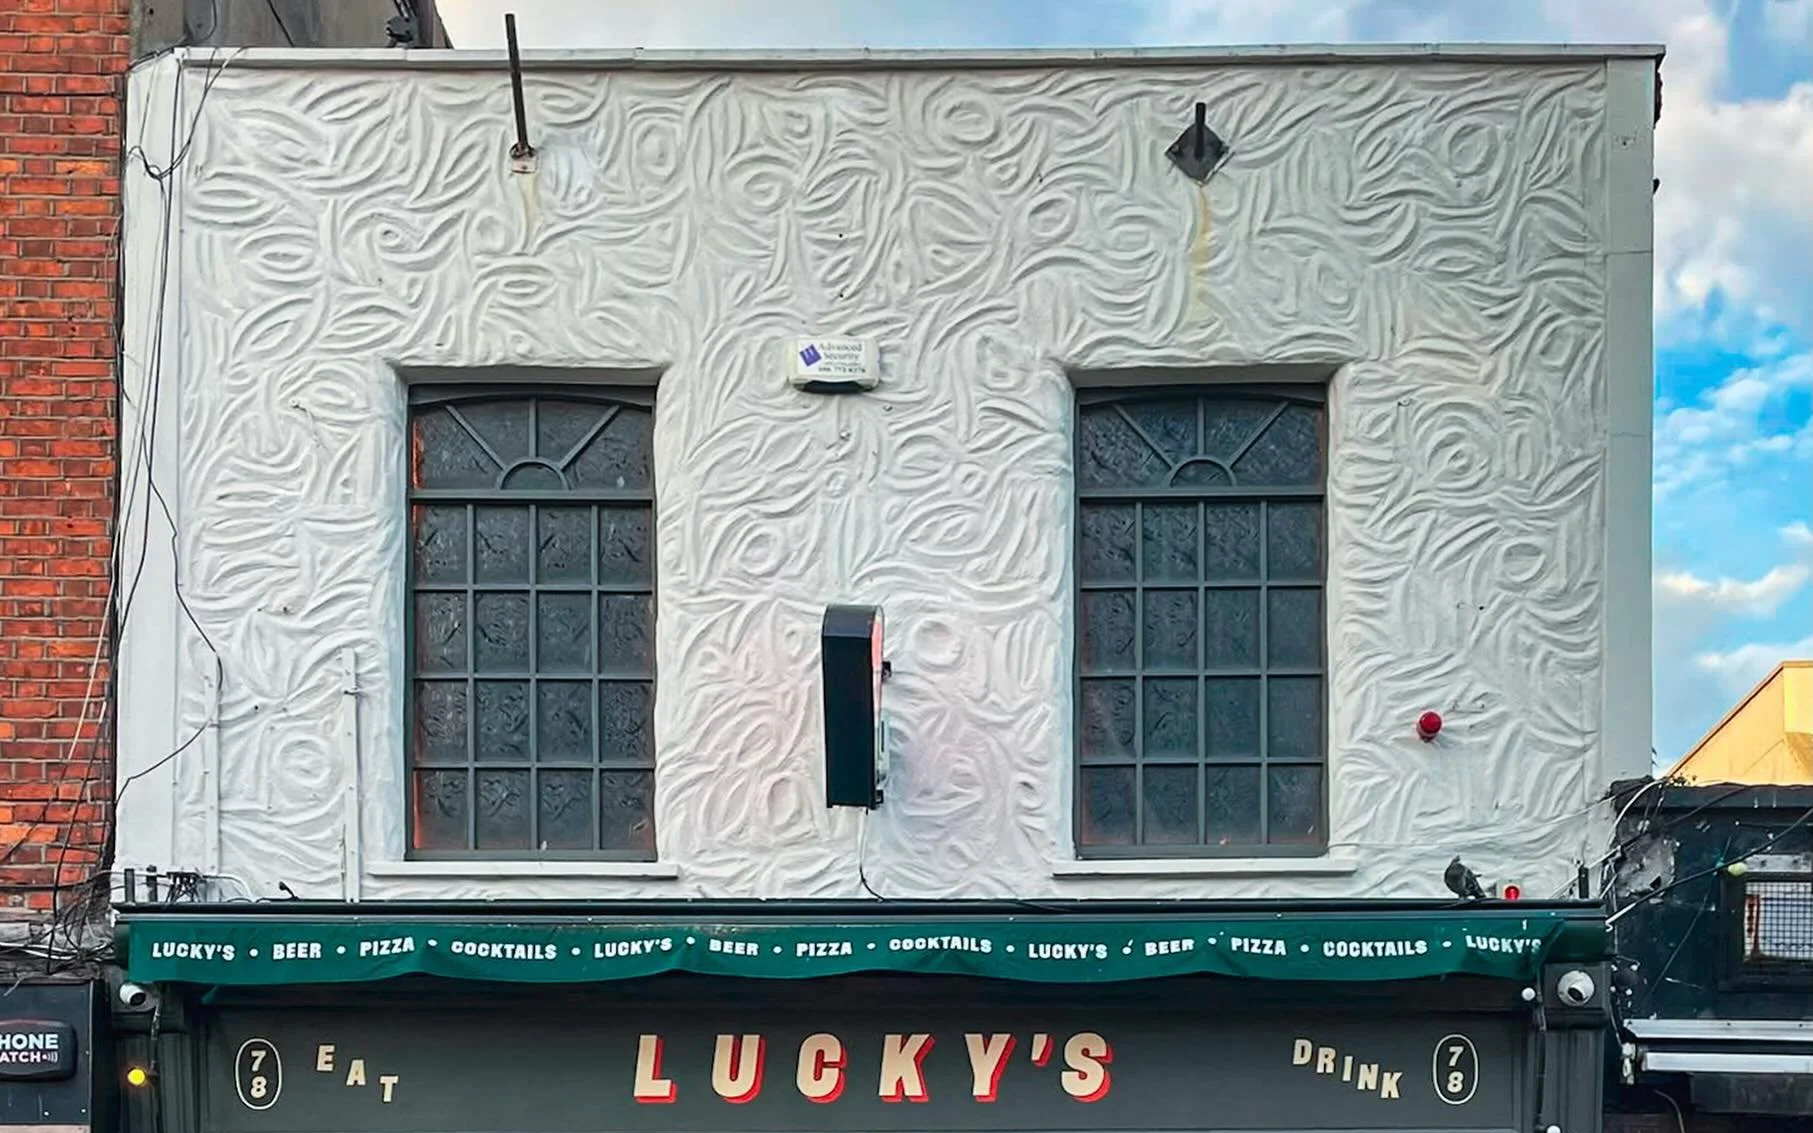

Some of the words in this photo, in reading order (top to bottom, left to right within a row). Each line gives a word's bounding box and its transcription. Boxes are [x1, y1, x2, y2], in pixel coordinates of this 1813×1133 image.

[152, 942, 235, 961] LUCKY'S
[273, 942, 322, 960] BEER
[359, 936, 415, 957] PIZZA
[451, 940, 557, 960] COCKTAILS
[594, 937, 673, 958] LUCKY'S
[709, 938, 759, 956] BEER
[796, 941, 853, 957] PIZZA
[888, 935, 992, 953] COCKTAILS
[1028, 943, 1108, 960] LUCKY'S
[1145, 938, 1195, 956] BEER
[1231, 937, 1287, 956] PIZZA
[1323, 940, 1428, 958] COCKTAILS
[1465, 935, 1542, 954] LUCKY'S
[316, 1045, 399, 1103] EAT
[633, 1033, 1113, 1104] LUCKY'S
[1292, 1038, 1403, 1100] DRINK
